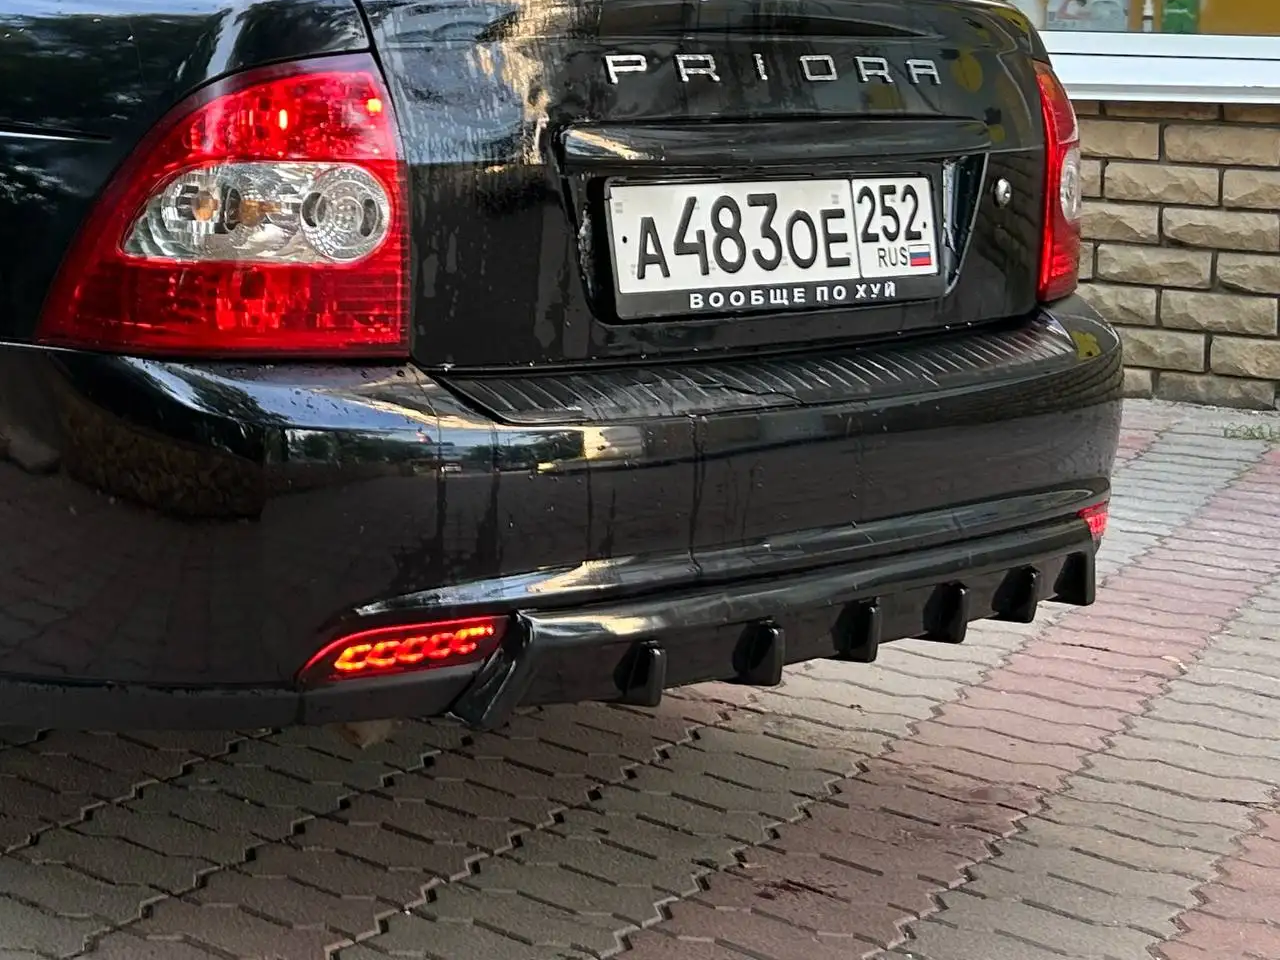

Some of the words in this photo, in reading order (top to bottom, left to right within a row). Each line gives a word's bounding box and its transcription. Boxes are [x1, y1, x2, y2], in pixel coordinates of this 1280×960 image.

[604, 53, 941, 85] PRIORA
[856, 184, 922, 246] 252
[878, 247, 908, 268] RUS
[689, 287, 806, 309] ВООБЩЕ
[816, 285, 846, 302] ПО
[855, 281, 896, 299] ХУЙ
